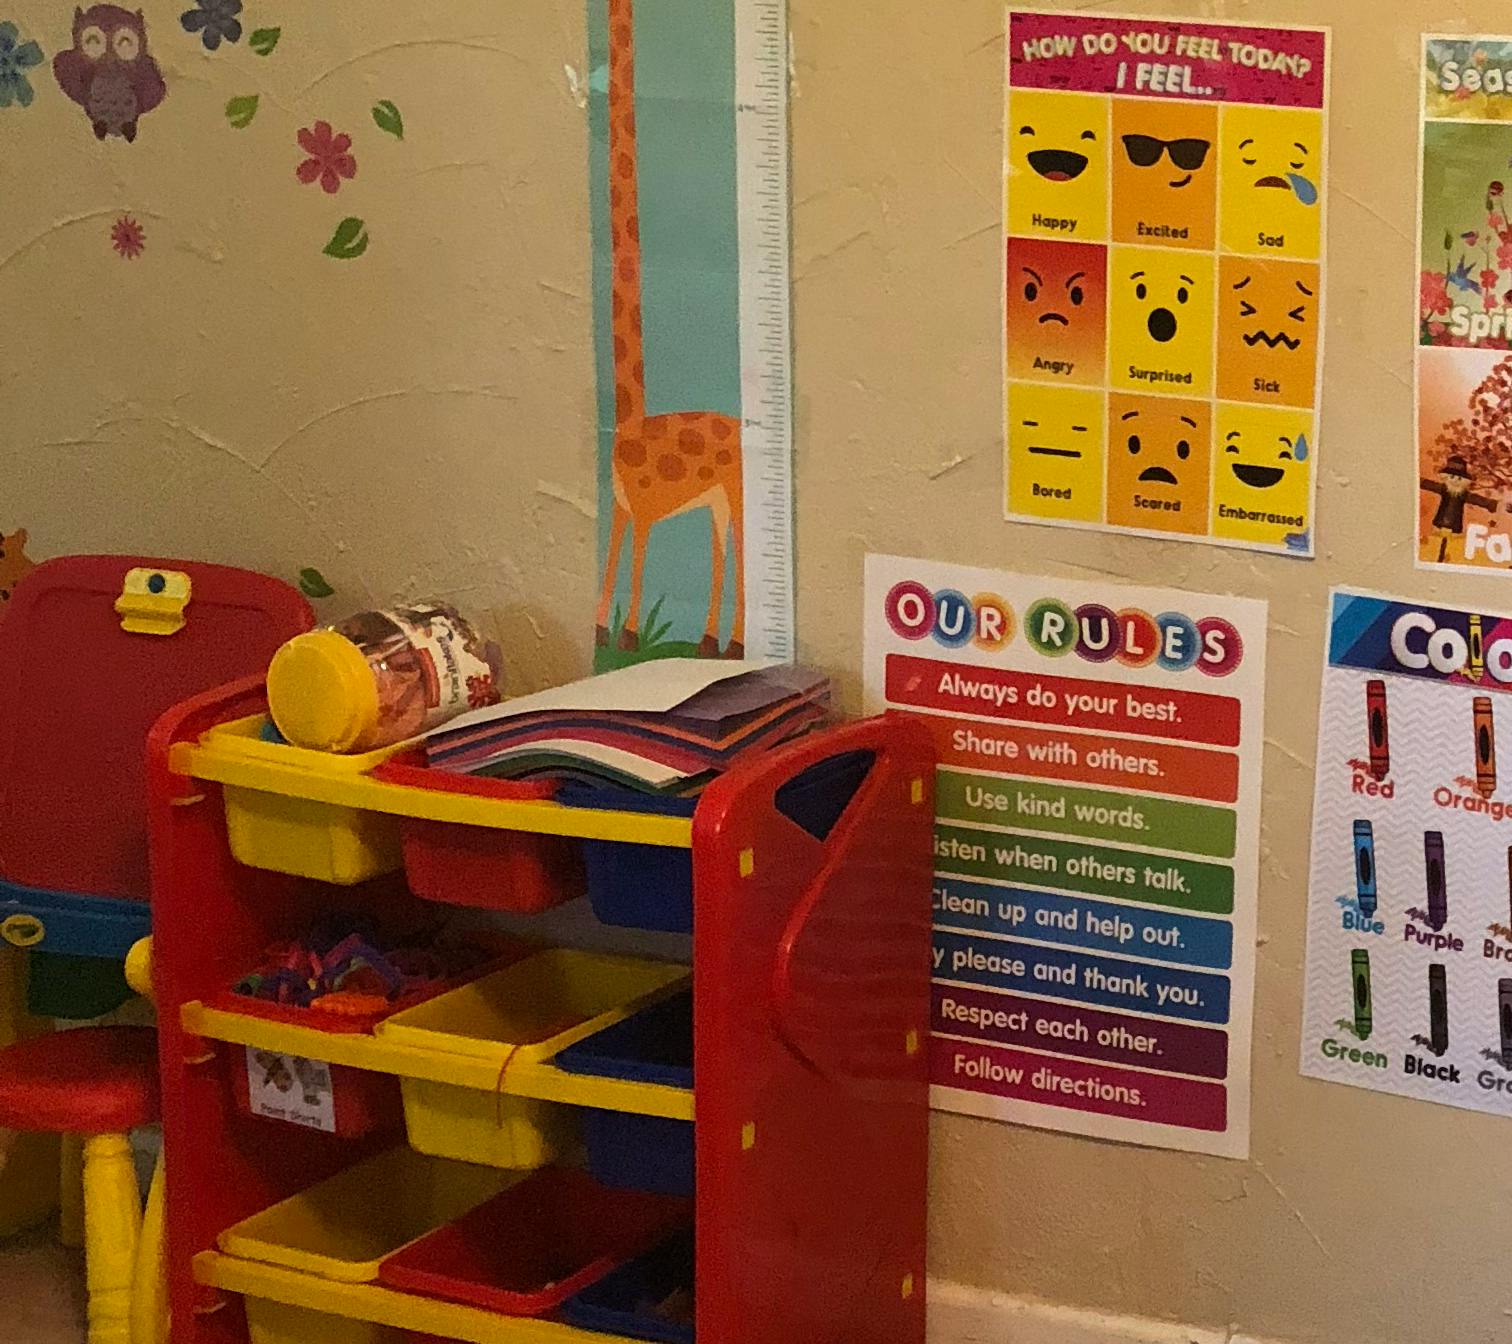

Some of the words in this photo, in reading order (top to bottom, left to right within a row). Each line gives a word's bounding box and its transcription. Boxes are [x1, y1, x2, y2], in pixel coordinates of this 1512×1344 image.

[1022, 34, 1076, 62] HOW
[1081, 32, 1117, 55] DO
[1121, 32, 1169, 59] YOU
[1175, 35, 1222, 62] FEEL
[1227, 40, 1313, 78] TODAY?
[1117, 62, 1126, 89] I
[1031, 214, 1078, 233] Happy
[1136, 222, 1189, 241] Excited
[1257, 233, 1285, 248] Sad
[1033, 357, 1074, 376] Angry
[1129, 366, 1193, 386] Surprised
[1253, 378, 1281, 394] Sick
[1032, 484, 1072, 500] Bored
[1134, 494, 1181, 513] Scared
[1218, 504, 1304, 528] Embarrassed
[896, 591, 1004, 641] OUR
[1041, 611, 1226, 663] RULES
[938, 672, 1018, 706] Always
[1027, 683, 1057, 708] do
[1064, 692, 1117, 719] your
[1125, 696, 1182, 723] best.
[952, 730, 1018, 759] Share
[1028, 741, 1078, 766] with
[1086, 748, 1166, 776] others.
[1351, 775, 1394, 799] Red
[965, 787, 1008, 812] Use
[1016, 792, 1066, 820] kind
[1074, 802, 1150, 831] words.
[934, 836, 986, 862] isten
[994, 841, 1057, 872] when
[1066, 852, 1136, 885] others
[1143, 866, 1191, 893] talk.
[998, 901, 1028, 924] up
[1035, 906, 1078, 930] and
[1086, 911, 1133, 944] help
[1142, 925, 1185, 948] out.
[1342, 911, 1385, 936] Blue
[1404, 924, 1464, 954] Purple
[953, 950, 1026, 983] please
[1033, 960, 1076, 986] and
[1084, 968, 1149, 999] thank
[1156, 982, 1205, 1008] you.
[941, 999, 1029, 1033] Respect
[1036, 1017, 1089, 1042] each
[1097, 1027, 1163, 1056] other.
[1321, 1038, 1388, 1068] Green
[954, 1056, 1024, 1085] Follow
[1031, 1066, 1147, 1108] directions.
[1404, 1055, 1461, 1084] Black
